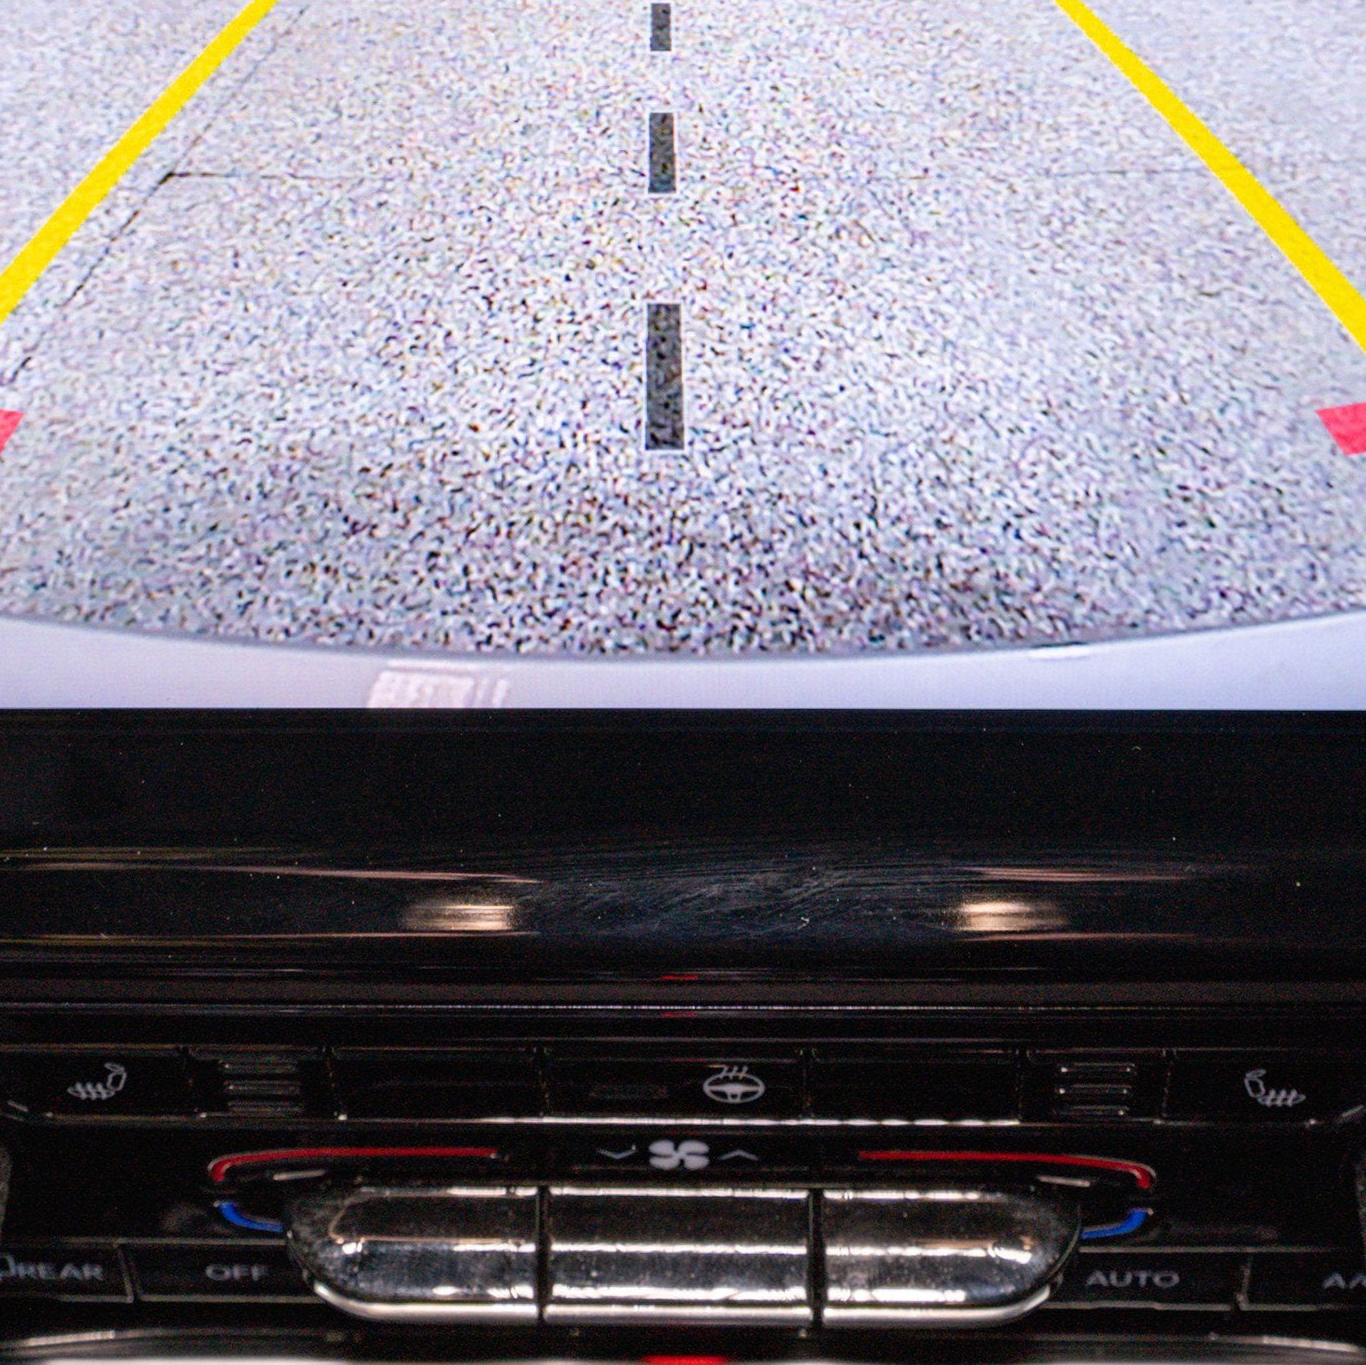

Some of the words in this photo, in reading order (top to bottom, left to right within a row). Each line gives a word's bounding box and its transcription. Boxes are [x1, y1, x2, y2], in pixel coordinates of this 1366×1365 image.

[16, 1262, 106, 1281] REAR
[205, 1263, 268, 1282] OFF
[1086, 1270, 1181, 1288] AUTO
